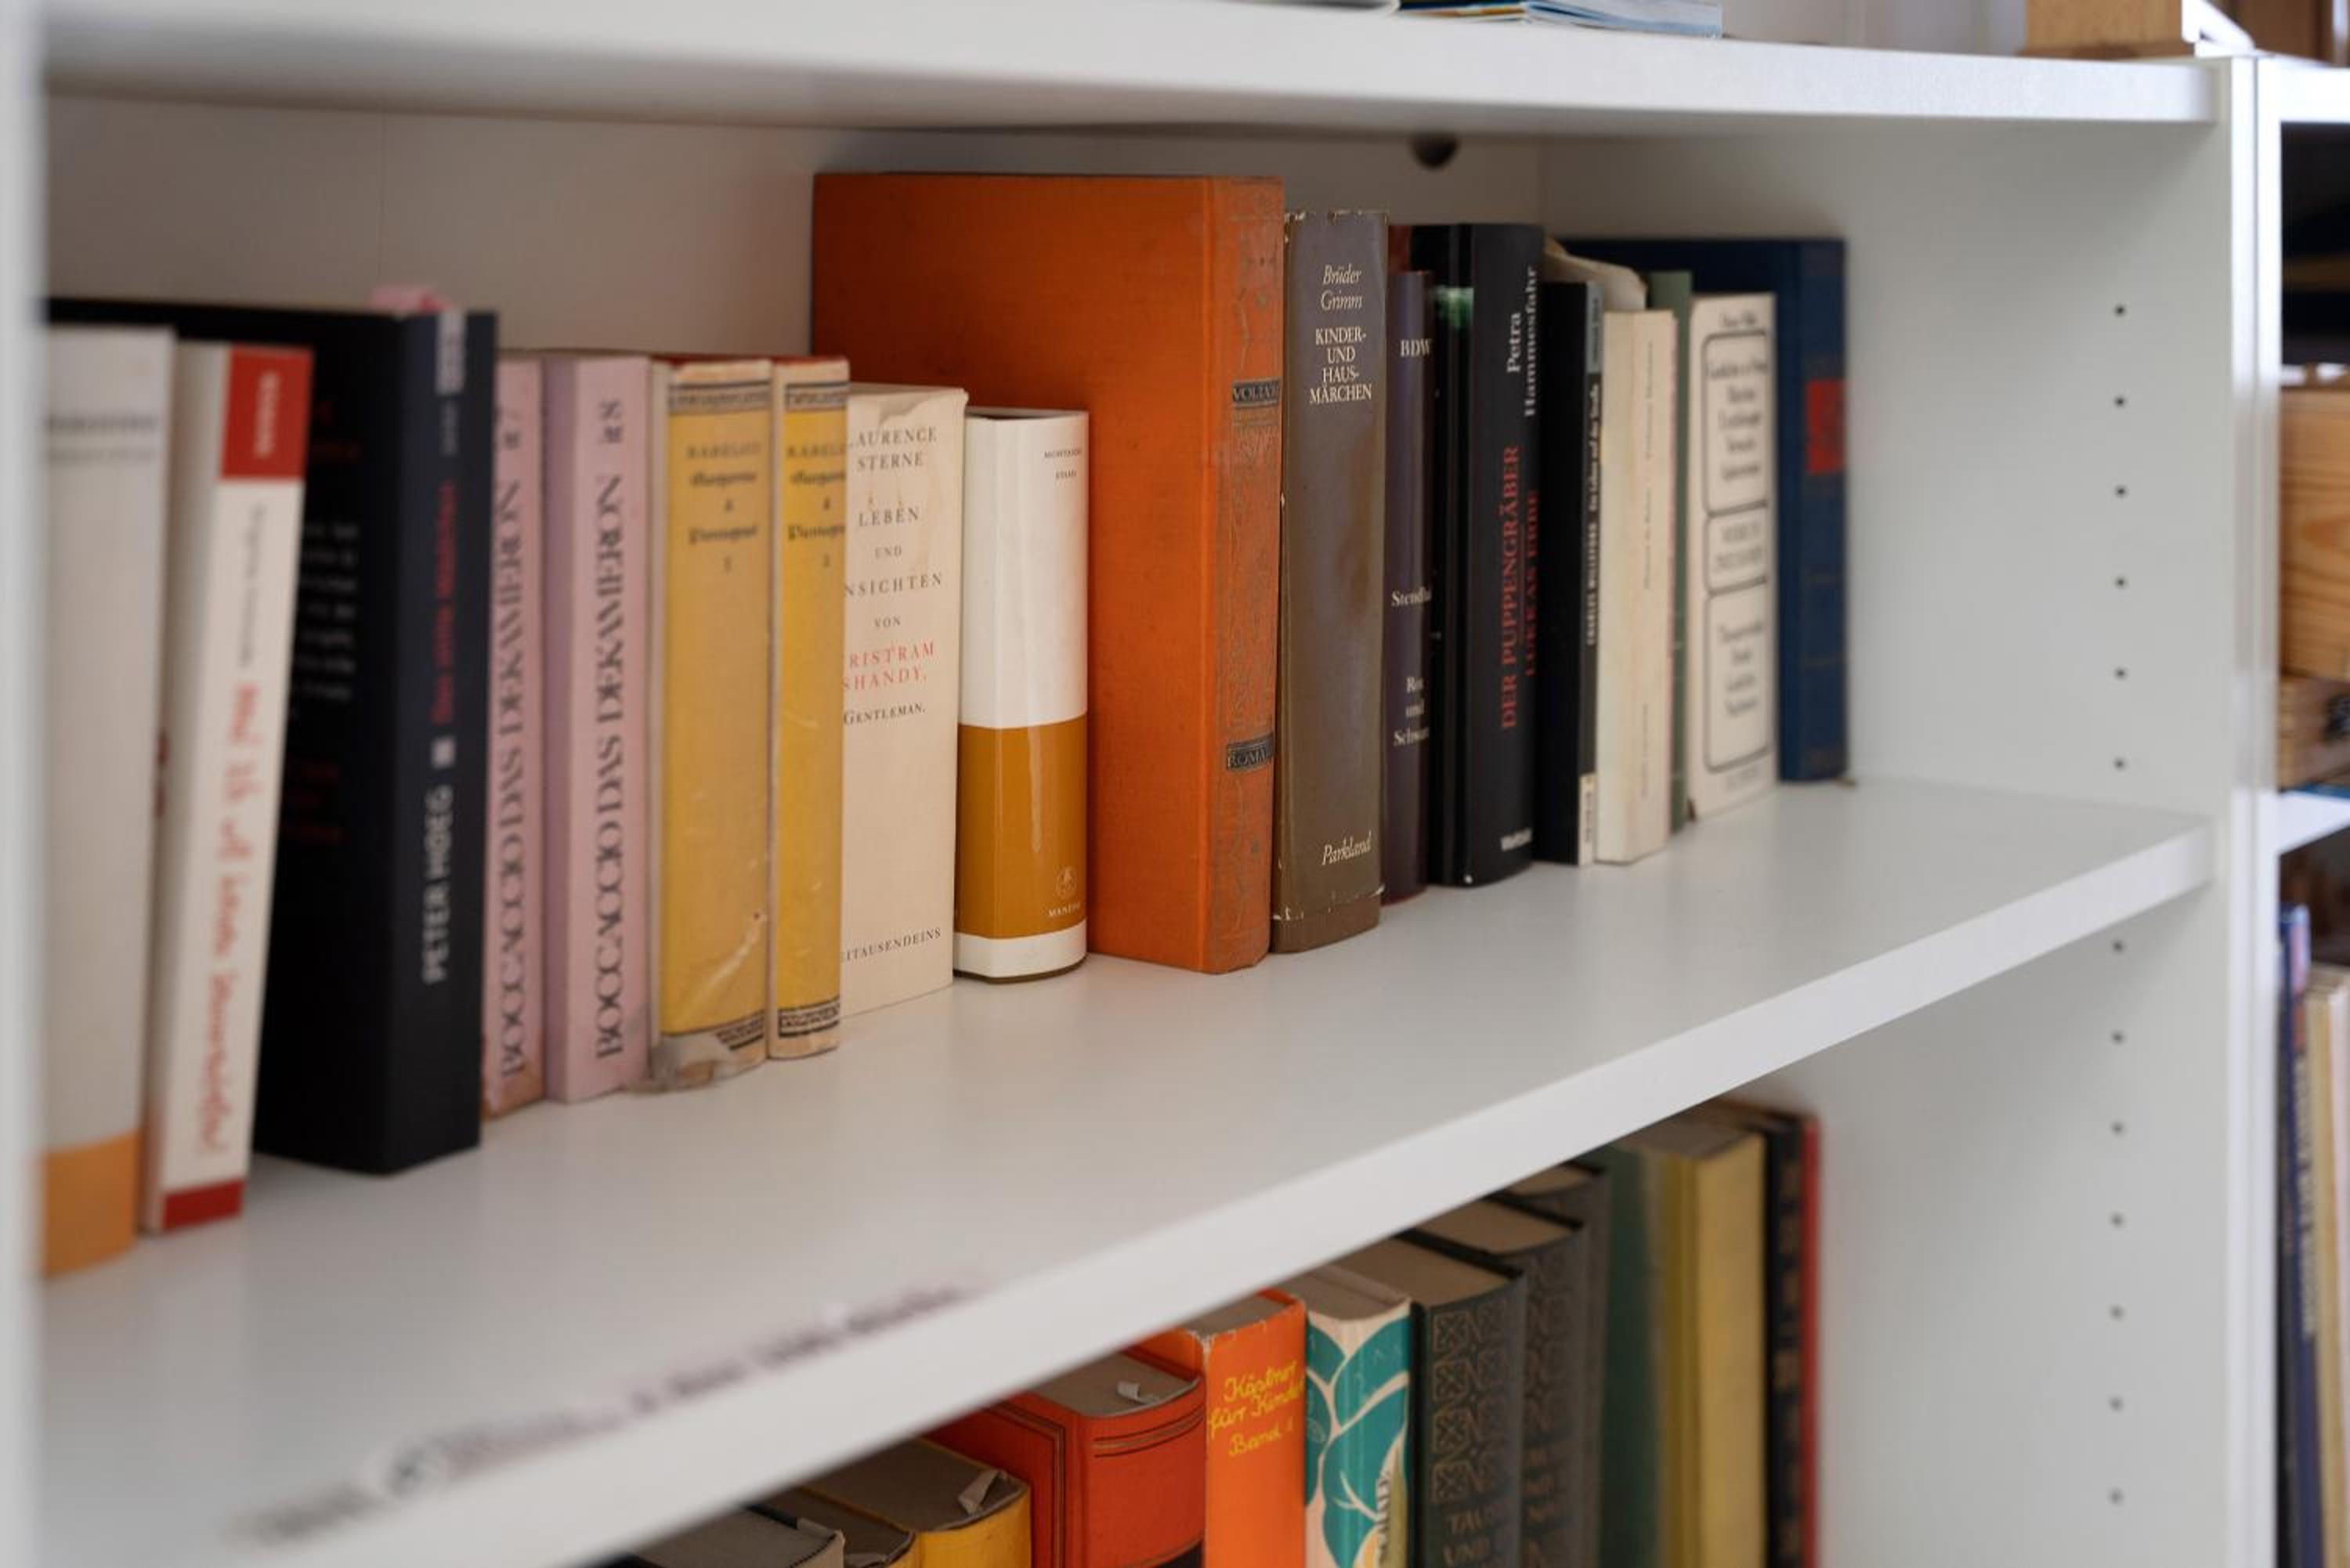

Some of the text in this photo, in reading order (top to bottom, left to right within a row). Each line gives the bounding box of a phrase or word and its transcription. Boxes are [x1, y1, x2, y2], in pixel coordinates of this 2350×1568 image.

[1322, 263, 1362, 285] Brüder
[1320, 290, 1363, 311] Grimm
[1315, 325, 1367, 345] KINDER-
[1506, 313, 1521, 373] Petra
[1524, 266, 1536, 417] Hammesfahr
[1326, 345, 1356, 364] UND
[1322, 364, 1360, 383] HAUS-
[1309, 381, 1372, 406] MÄRCHEN
[849, 426, 938, 449] AURENCE
[856, 450, 924, 471] STERNE
[858, 508, 920, 527] LEBEN
[874, 544, 902, 558] UND
[844, 573, 942, 598] NSICHTEN
[1499, 444, 1518, 728] DER PUPPENGRÄBER
[497, 479, 523, 735] DEKAMERON
[596, 475, 624, 724] DEKAMERON
[873, 616, 902, 630] VON
[849, 641, 935, 669] RISTRAM
[498, 747, 524, 828] DAS
[596, 734, 624, 815] DAS
[1321, 829, 1372, 866] Parkland
[595, 820, 624, 1058] BOCCACCIO
[841, 927, 942, 962] ITAUSENDEINS
[1227, 1422, 1282, 1457] Band
